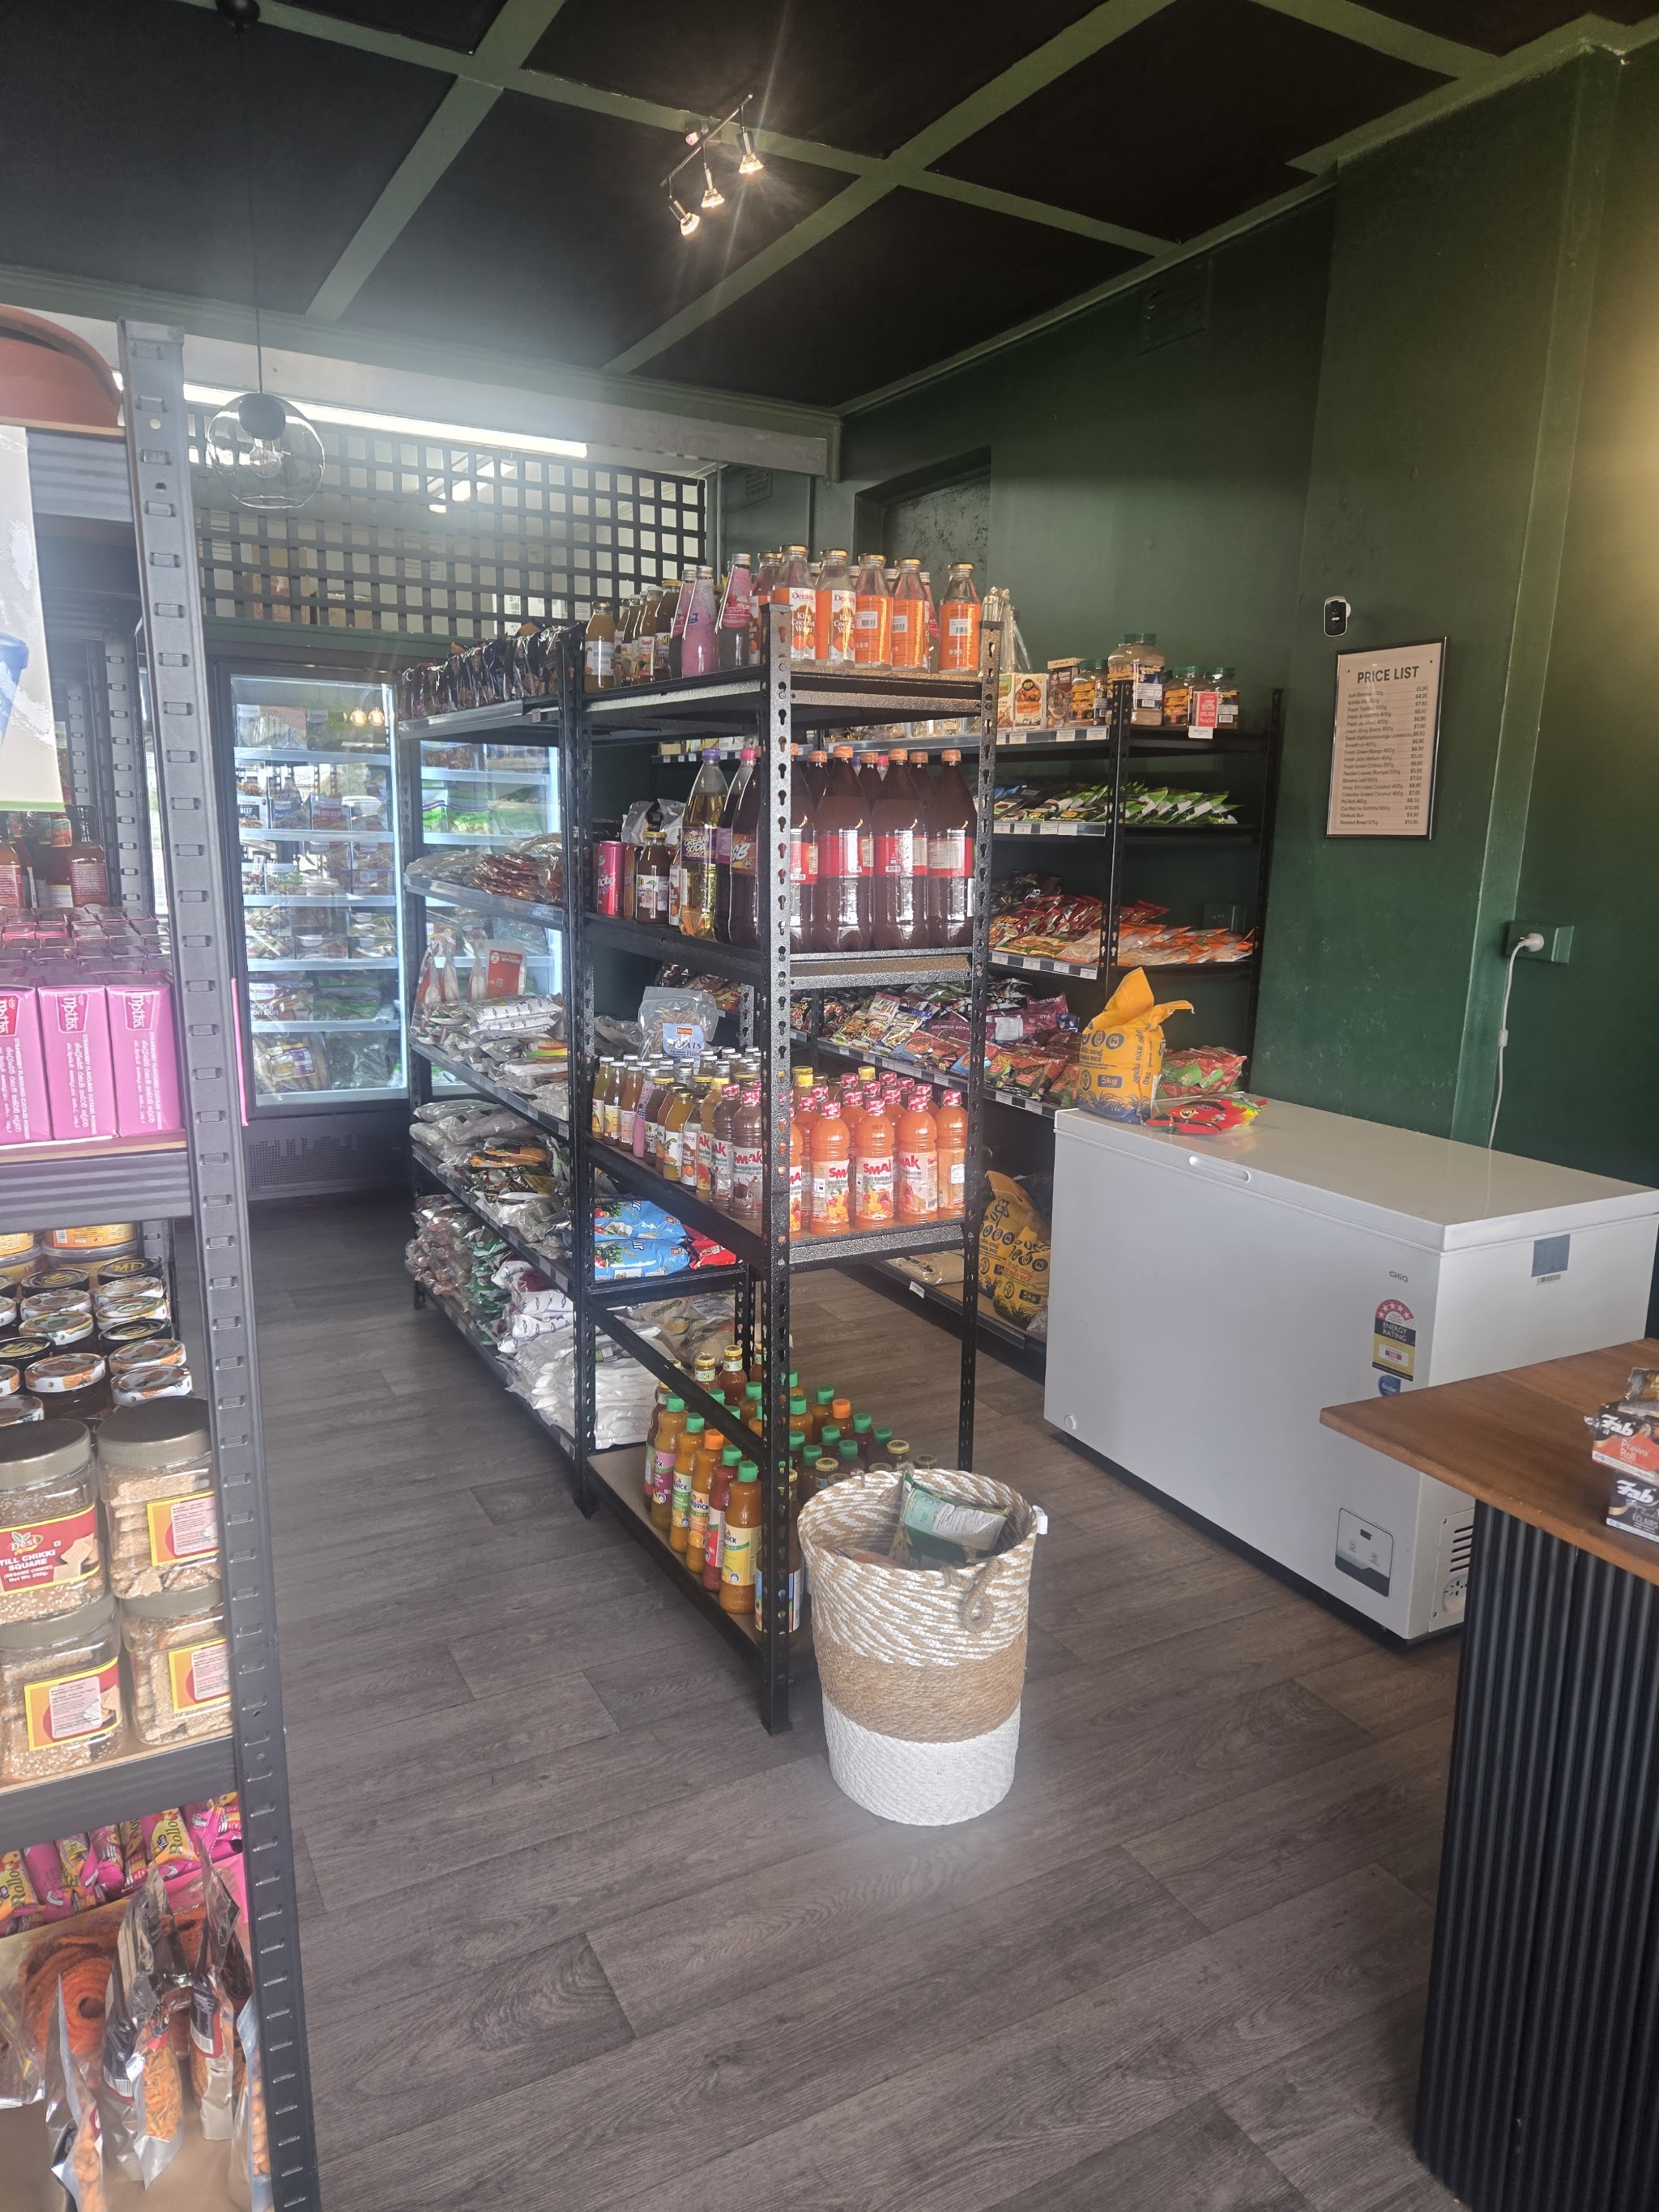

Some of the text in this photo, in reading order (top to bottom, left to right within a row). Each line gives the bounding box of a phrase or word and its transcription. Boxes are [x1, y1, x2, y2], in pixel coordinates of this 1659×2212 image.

[1357, 666, 1419, 683] PRICE LIST
[1101, 1076, 1117, 1085] 5kg
[1023, 1291, 1036, 1302] 5kg
[1382, 1328, 1406, 1342] RATING
[1383, 1321, 1407, 1335] ENERGY
[1601, 1414, 1633, 1436] Fab
[1620, 1448, 1636, 1462] Roll
[1621, 1439, 1648, 1457] Prawn
[1616, 1479, 1655, 1503] Fab
[10, 1536, 38, 1551] Desi
[0, 1549, 56, 1566] TILL CHIKKI
[8, 1558, 47, 1571] SQUARE
[4, 1565, 53, 1579] (SESAME CHIKKI)
[165, 1820, 183, 1855] Rollo
[7, 1871, 26, 1908] Rollo
